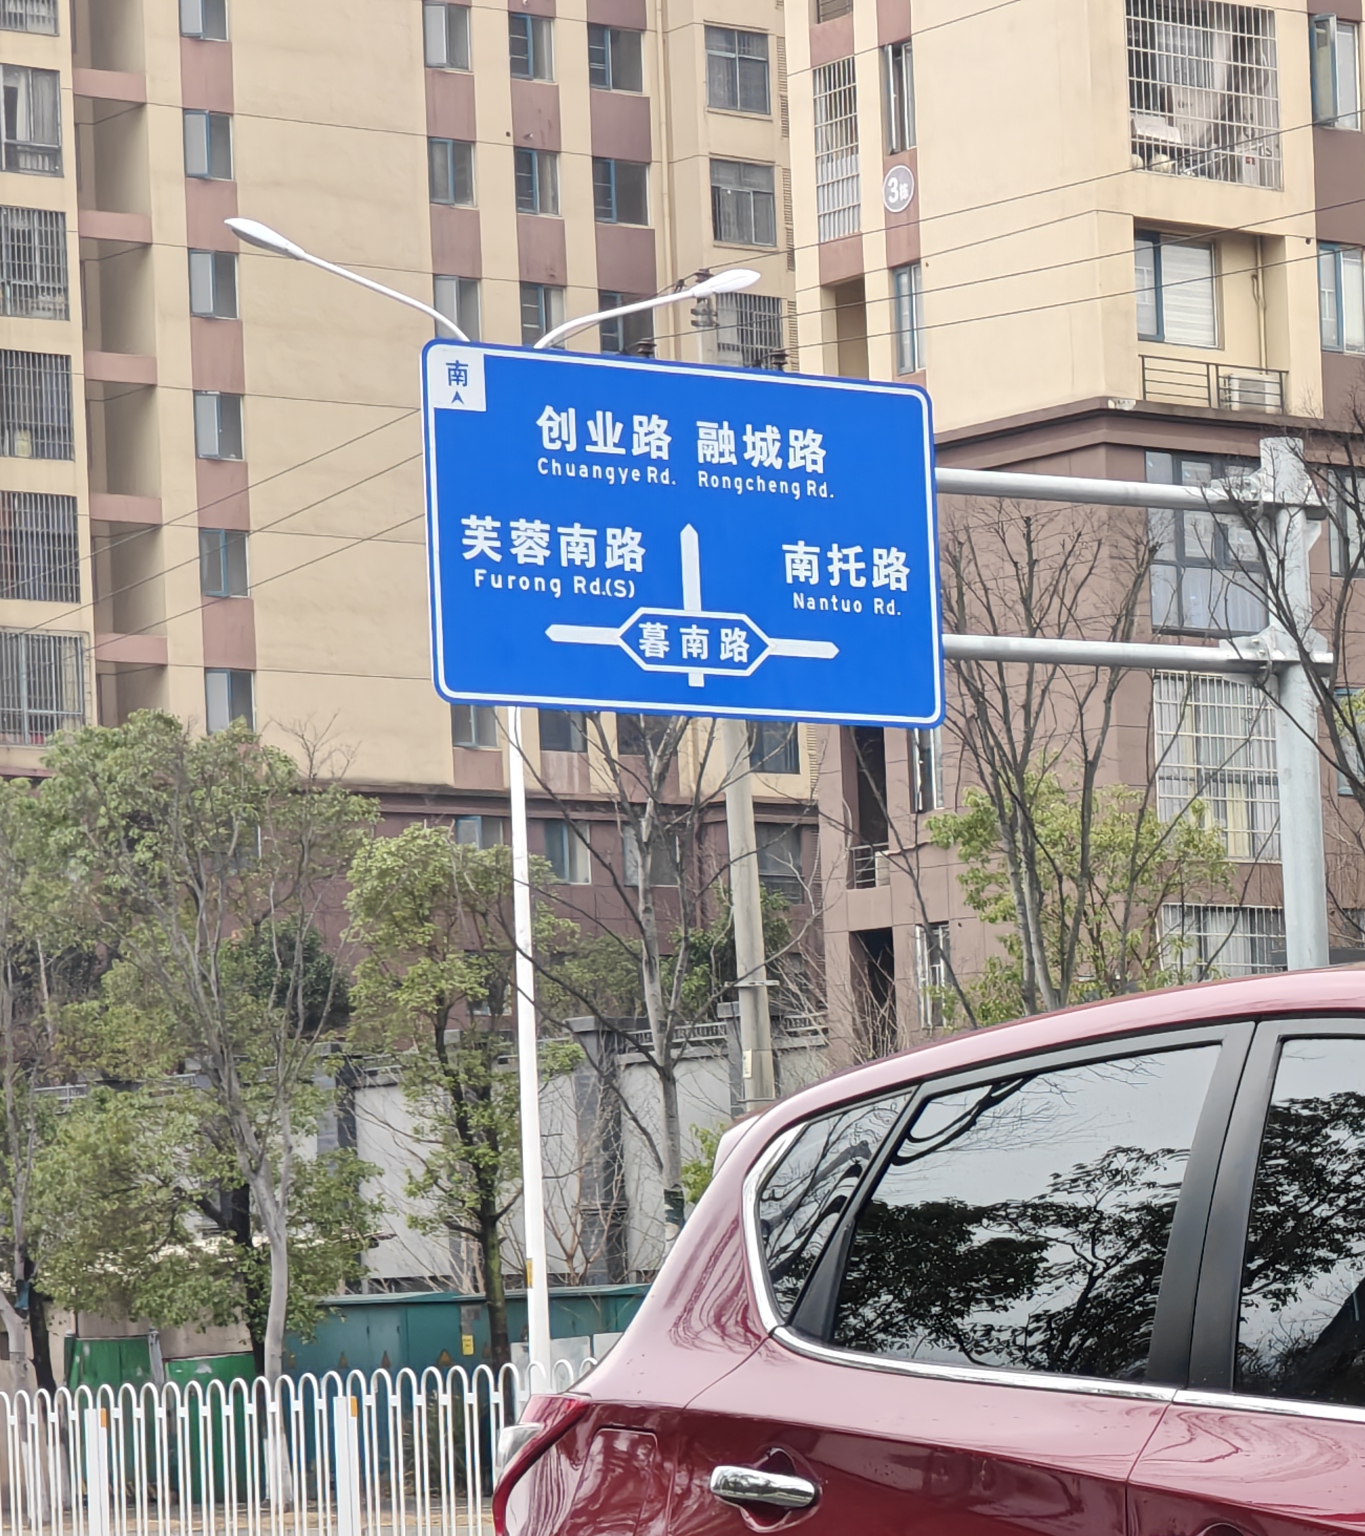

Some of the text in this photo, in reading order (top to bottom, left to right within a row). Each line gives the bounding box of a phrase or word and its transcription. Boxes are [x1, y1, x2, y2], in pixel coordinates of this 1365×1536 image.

[446, 360, 468, 386] 南
[536, 405, 827, 474] 创业路 融城路
[537, 457, 677, 485] Chuangye Rd.
[697, 469, 835, 500] Rongcheng Rd.
[461, 514, 646, 573] 芙蓉南路
[782, 540, 911, 592] 南托路
[474, 569, 636, 599] Furong Rd.(S)
[793, 592, 902, 616] Nantuo Rd.
[638, 621, 751, 663] 暮南路
